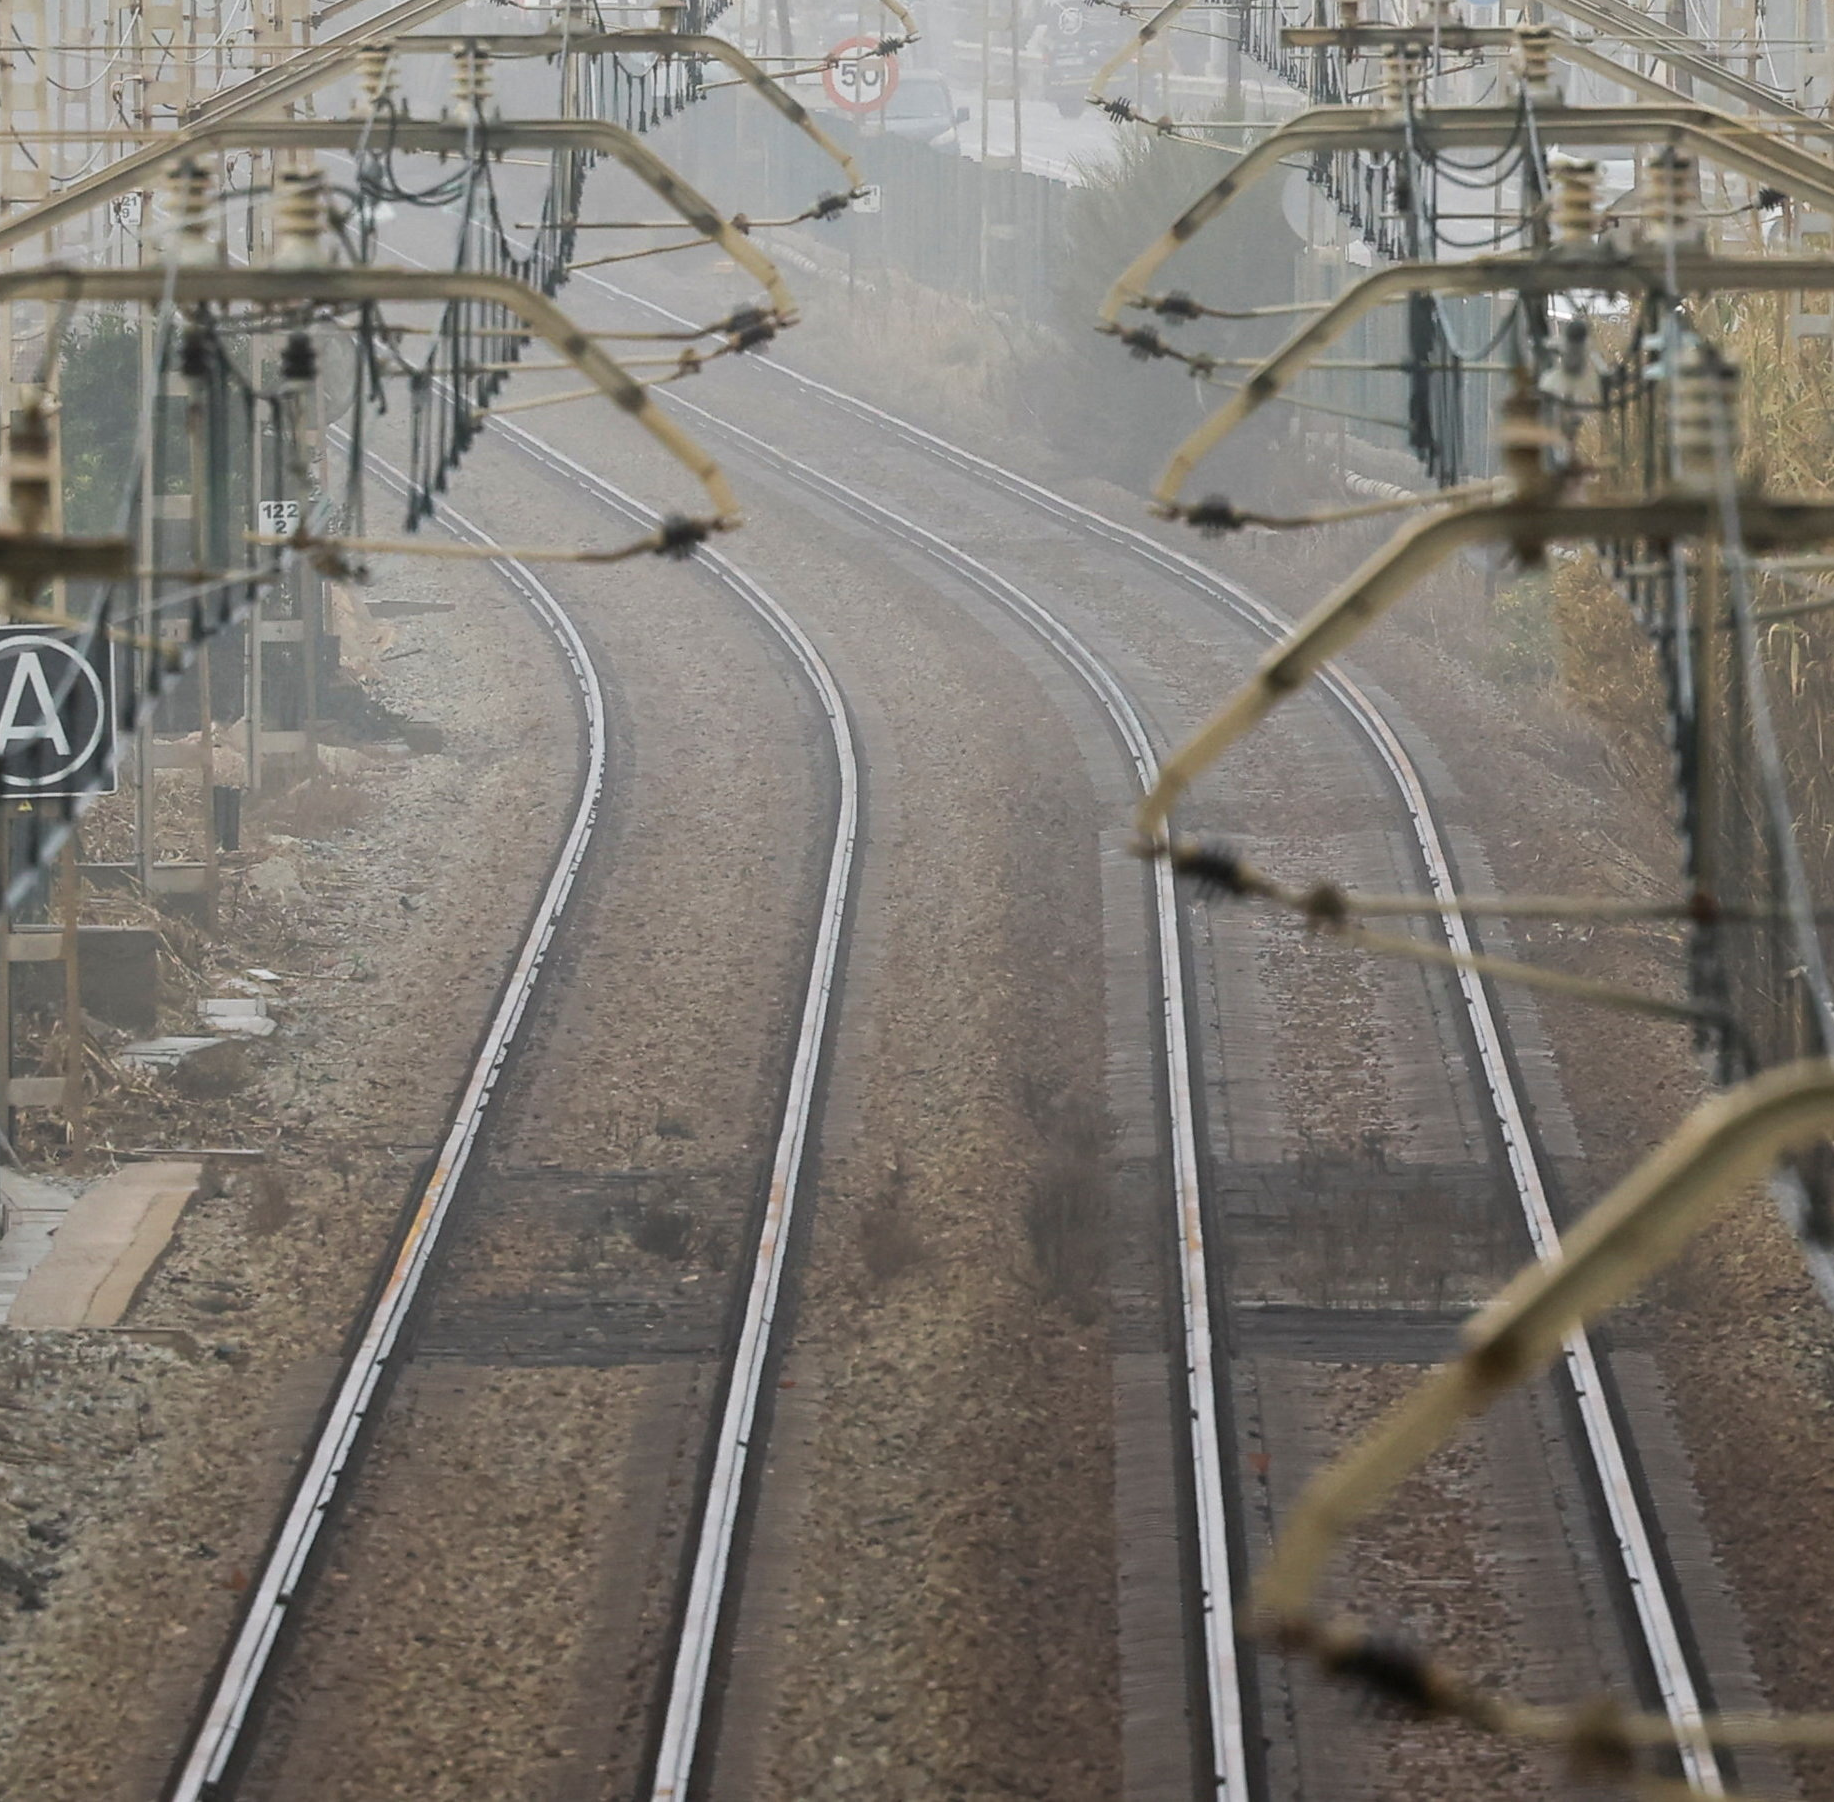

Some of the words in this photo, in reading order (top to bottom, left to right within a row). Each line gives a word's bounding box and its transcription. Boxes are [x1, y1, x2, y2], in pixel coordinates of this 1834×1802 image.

[841, 63, 879, 86] 50
[263, 503, 298, 519] 122
[275, 520, 287, 534] 2
